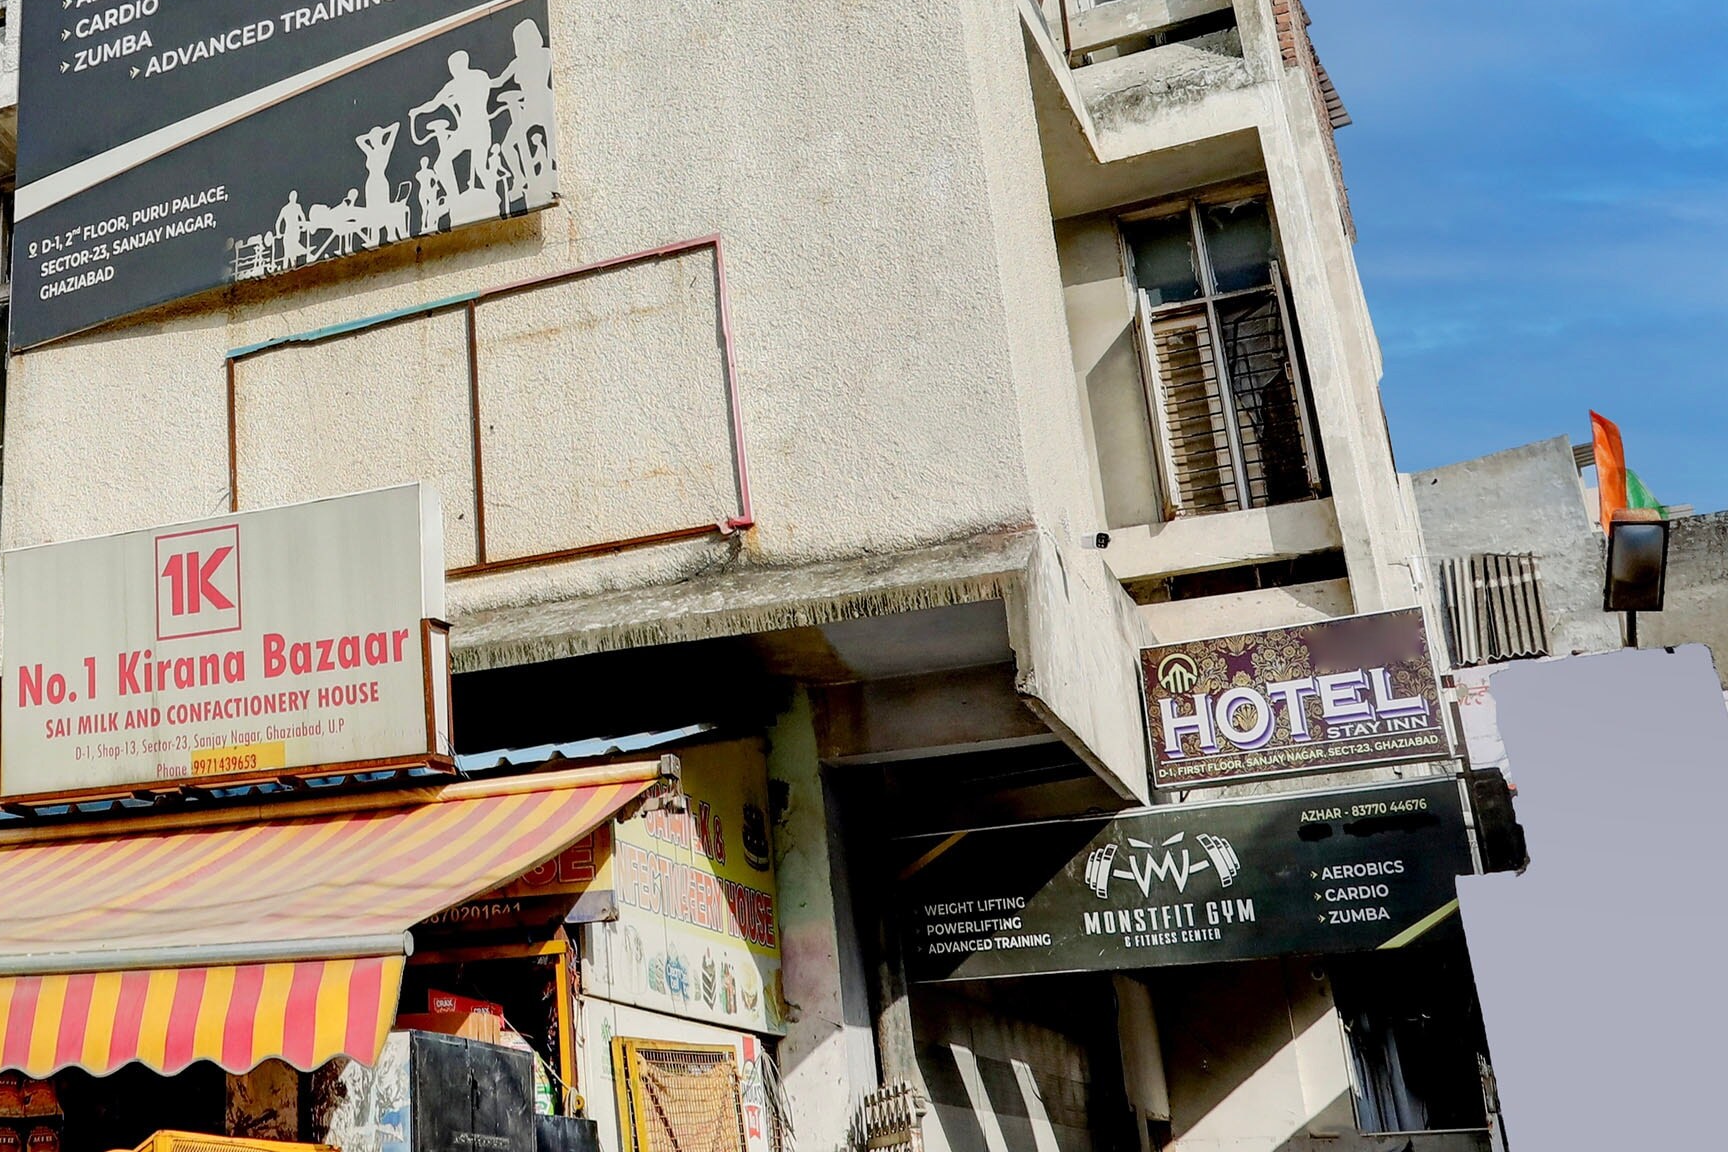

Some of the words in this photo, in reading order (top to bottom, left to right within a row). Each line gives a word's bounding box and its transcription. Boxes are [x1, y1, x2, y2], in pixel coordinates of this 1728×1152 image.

[73, 29, 153, 73] ZUMBA
[144, 18, 275, 78] ADVANCED
[42, 236, 63, 254] D-1,
[83, 215, 129, 240] FLOOR,
[132, 202, 169, 226] PURU
[172, 185, 228, 214] PALACE,
[41, 246, 110, 277] SECTOR-23,
[112, 227, 163, 256] SANJAY
[166, 212, 217, 239] NAGAR,
[40, 265, 115, 300] GHAZIABAD
[160, 545, 236, 616] 1K
[18, 656, 97, 708] No.1
[118, 648, 246, 696] Kirana
[262, 627, 409, 679] Bazaar
[45, 718, 71, 739] SAI
[77, 711, 119, 736] MILK
[124, 707, 161, 731] AND
[166, 689, 310, 726] CONFACTIONERY
[317, 681, 380, 708] HOUSE
[1159, 668, 1430, 759] HOTEL
[1326, 722, 1381, 739] STAY
[1387, 715, 1428, 731] INN
[97, 741, 139, 760] Shop-13,
[142, 736, 191, 754] Sector-23,
[193, 732, 227, 752] Sanjay
[230, 730, 263, 747] Nagar,
[266, 723, 324, 741] Ghaziabad,
[328, 719, 345, 734] U.P
[1178, 764, 1207, 776] FIRST
[1246, 754, 1286, 768] SANJAY
[1374, 734, 1439, 753] GHAZIABAD
[156, 763, 187, 778] Phone
[1300, 806, 1342, 823] AZHAR
[1352, 801, 1387, 818] 83770
[1389, 797, 1427, 815] 44676
[1320, 860, 1404, 881] AEROBICS
[924, 901, 974, 916] WEIGHT
[977, 896, 1025, 912] LIFTING
[1324, 883, 1389, 902] CARDIO
[725, 879, 776, 948] HOUSE
[926, 917, 1022, 936] POWERLIFTING
[1083, 903, 1194, 935] MONSTFIT
[1206, 898, 1256, 926] GYM
[1328, 906, 1391, 924] ZUMBA
[928, 938, 993, 955] ADVANCED
[994, 933, 1052, 949] TRAINING
[1133, 931, 1179, 946] FITNESS
[1181, 927, 1222, 943] CENTER
